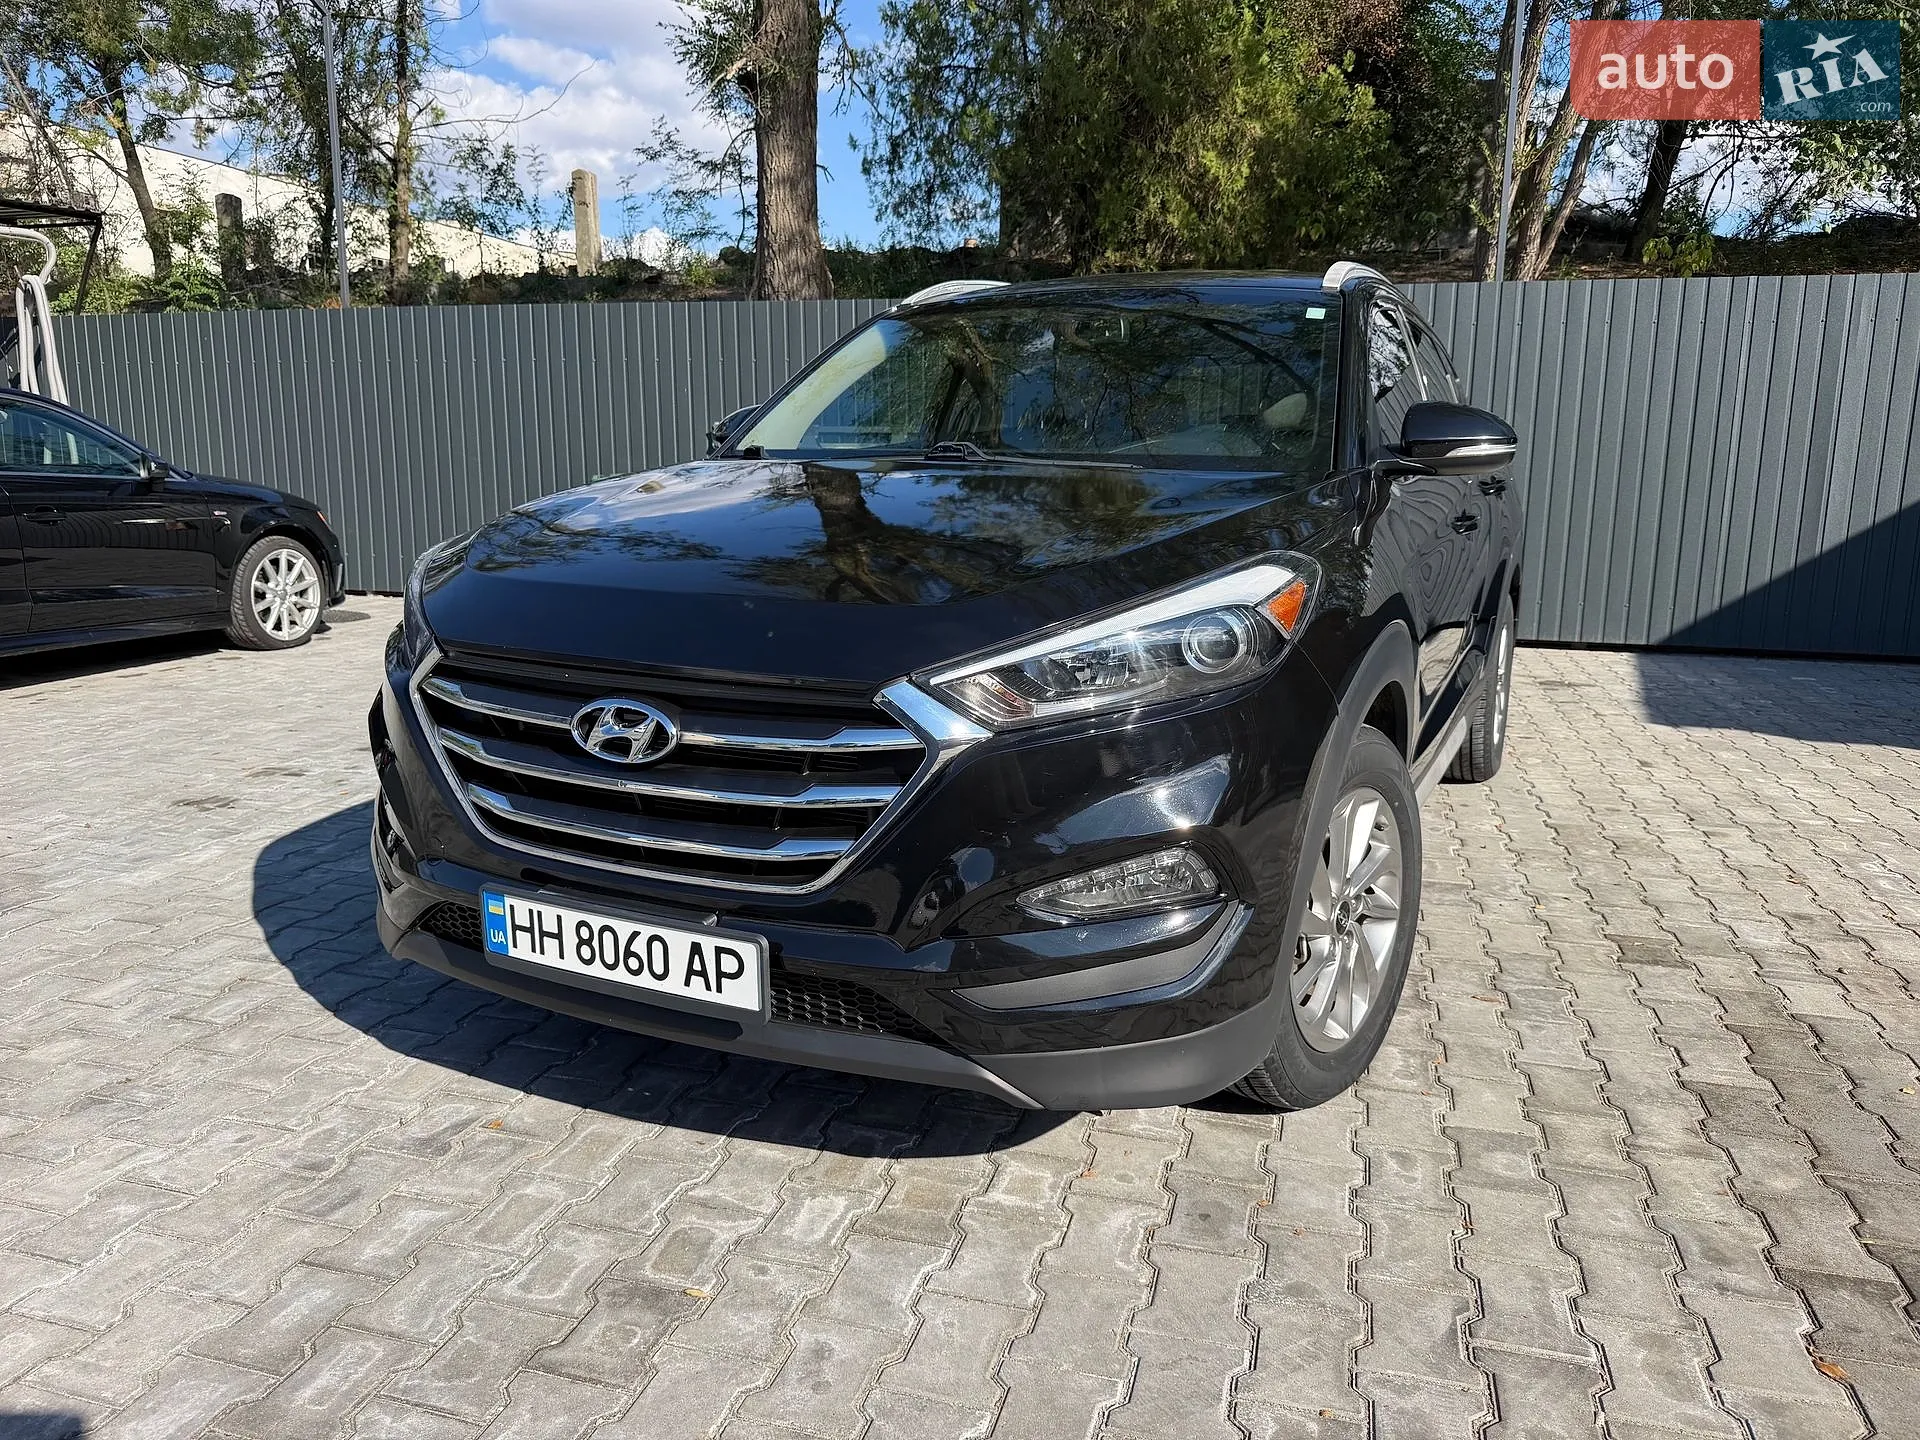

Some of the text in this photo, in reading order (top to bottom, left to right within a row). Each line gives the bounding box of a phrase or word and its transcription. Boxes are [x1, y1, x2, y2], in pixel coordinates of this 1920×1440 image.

[491, 928, 507, 945] UA
[509, 904, 745, 993] HH 8060 AP
